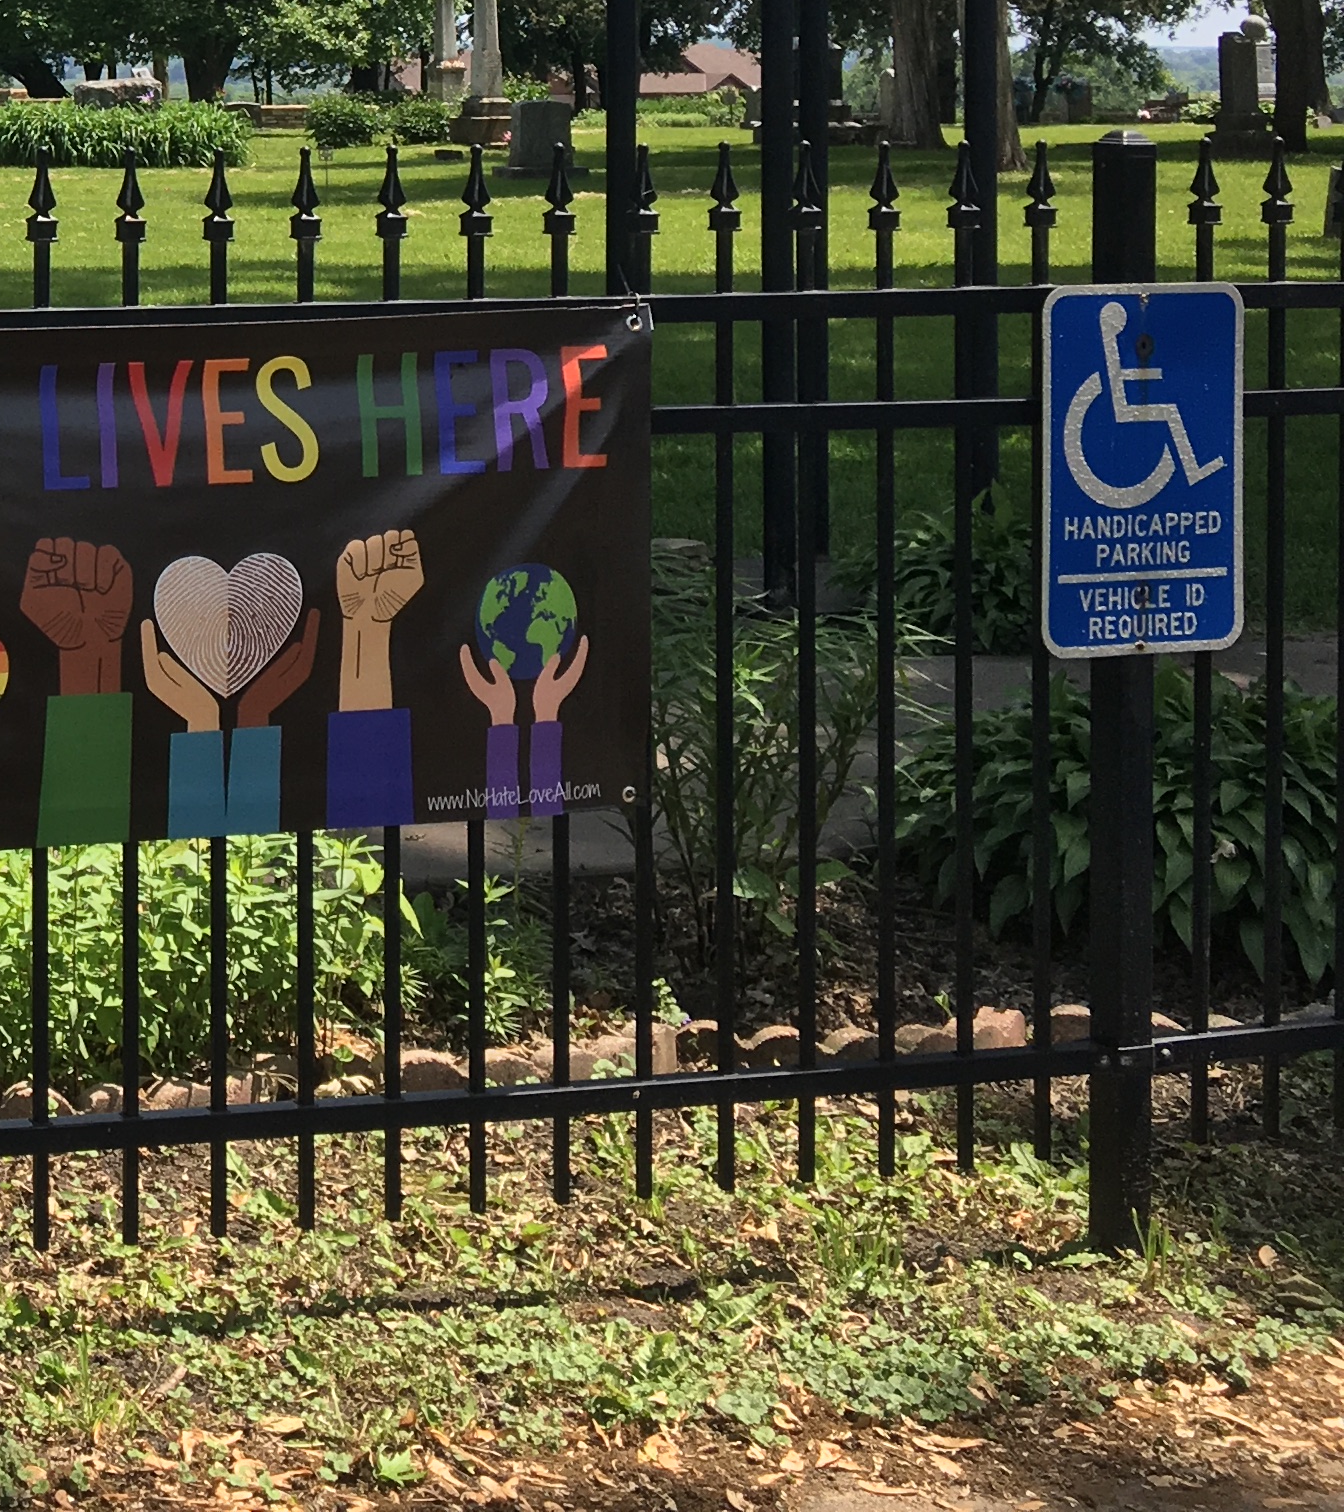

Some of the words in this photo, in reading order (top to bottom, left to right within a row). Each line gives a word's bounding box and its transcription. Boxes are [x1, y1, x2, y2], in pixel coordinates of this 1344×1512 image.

[37, 355, 320, 490] LIVES
[355, 344, 608, 479] HERE
[1063, 510, 1222, 542] HANDICAPPED
[1096, 541, 1191, 568] PARKING
[1079, 584, 1172, 613] VEHICLE
[1185, 582, 1205, 607] ID
[1089, 611, 1198, 641] REQUIRED
[427, 781, 601, 811] www.NoHateLoveAll.com
